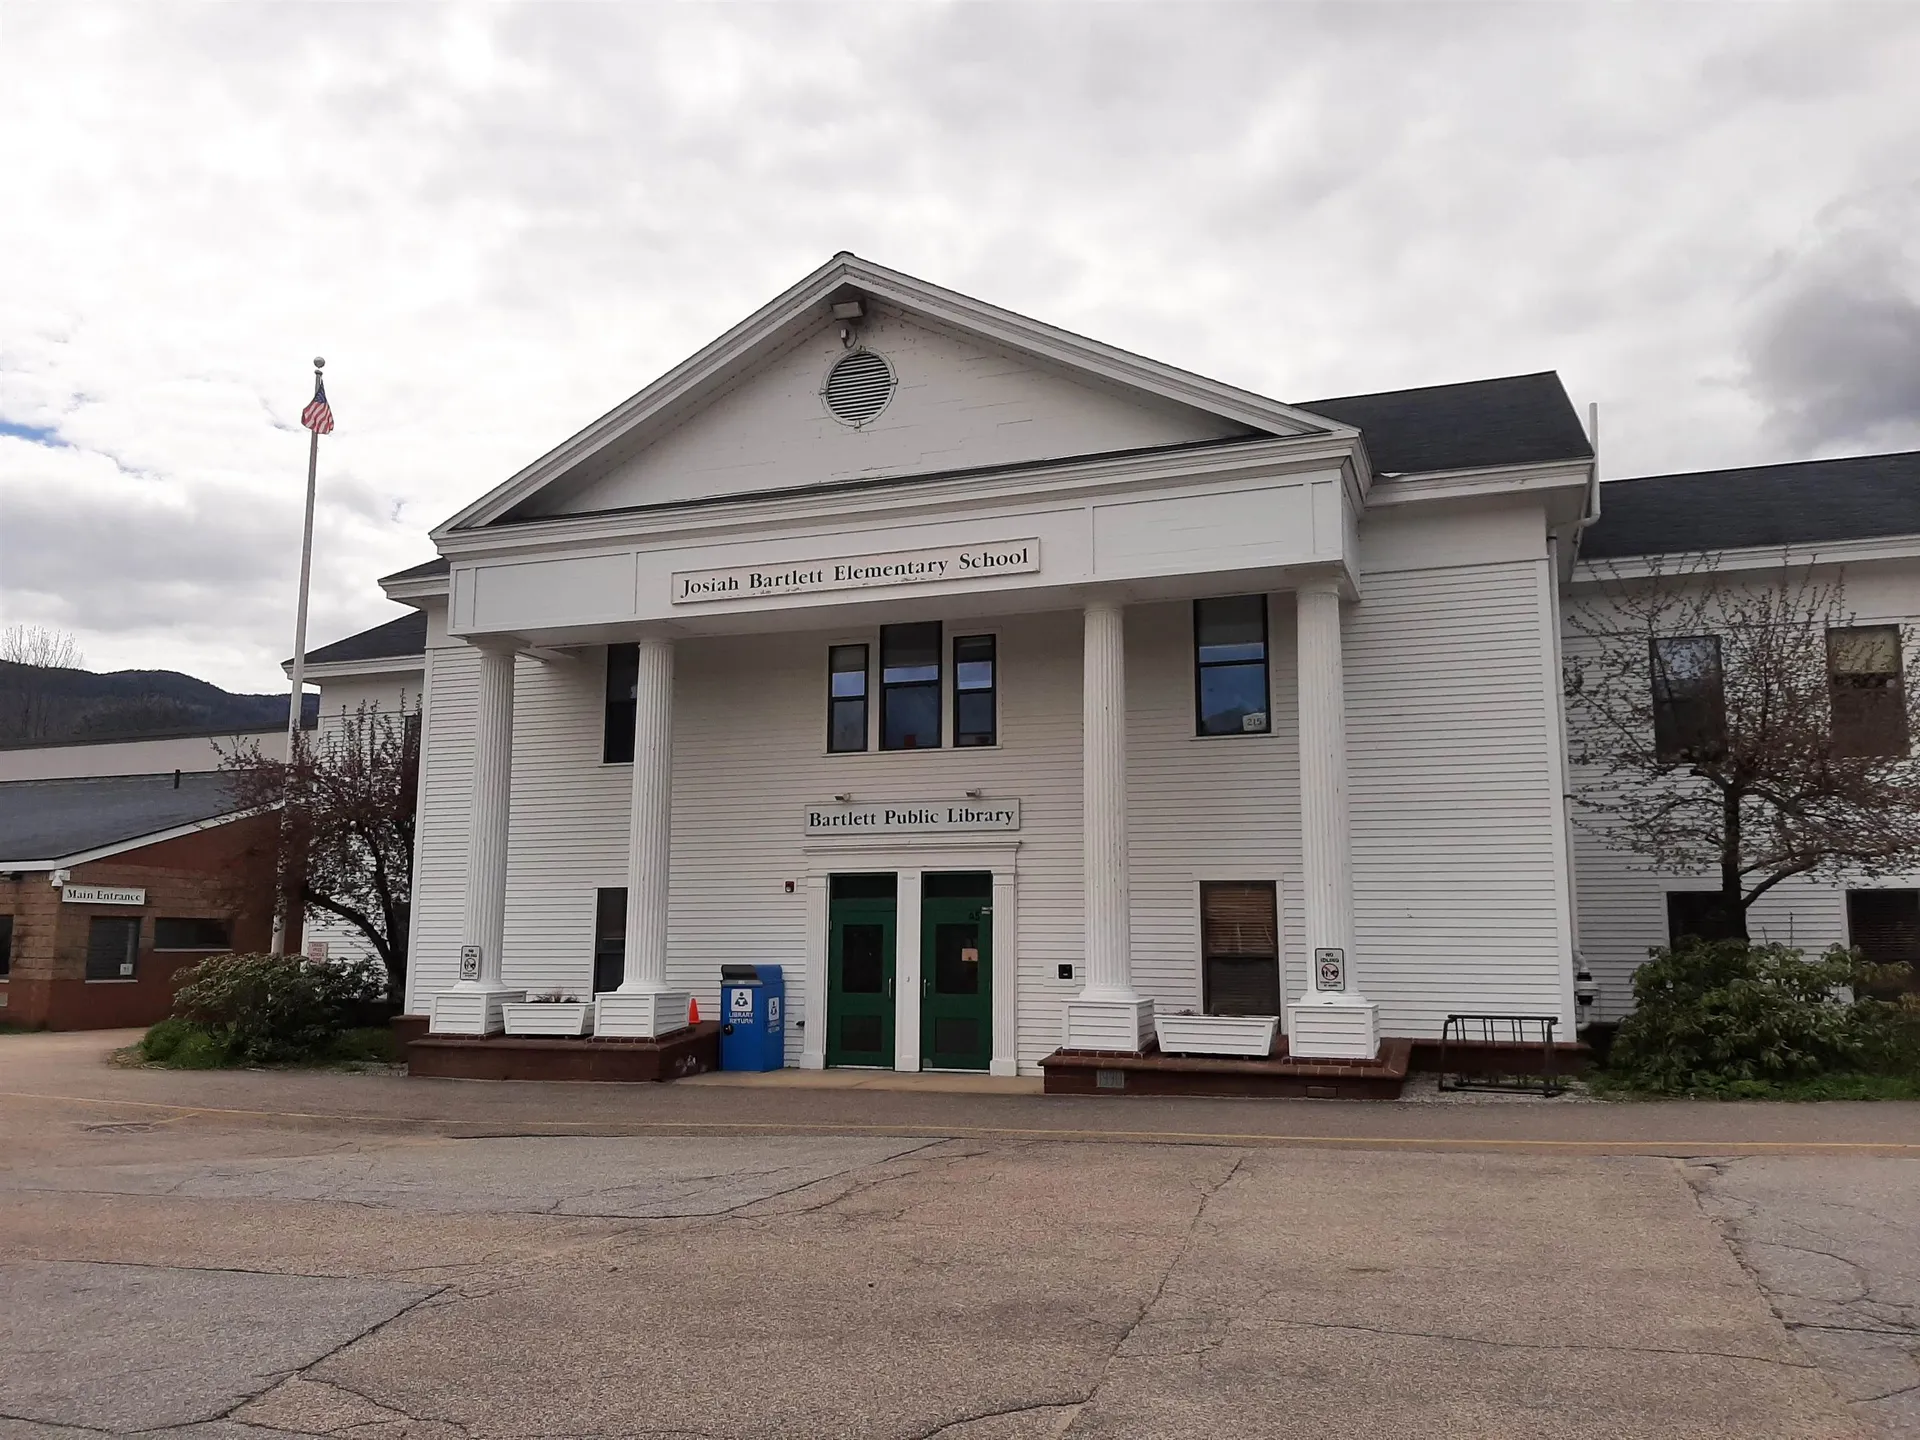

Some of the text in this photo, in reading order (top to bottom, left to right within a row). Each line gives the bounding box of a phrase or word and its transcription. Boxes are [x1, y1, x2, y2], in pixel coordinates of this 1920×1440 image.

[680, 547, 1029, 599] Josiah Bartlett Elementary School
[1246, 717, 1262, 726] 215
[809, 807, 1015, 828] Bartlett Public Library
[67, 889, 141, 901] Main Entrance
